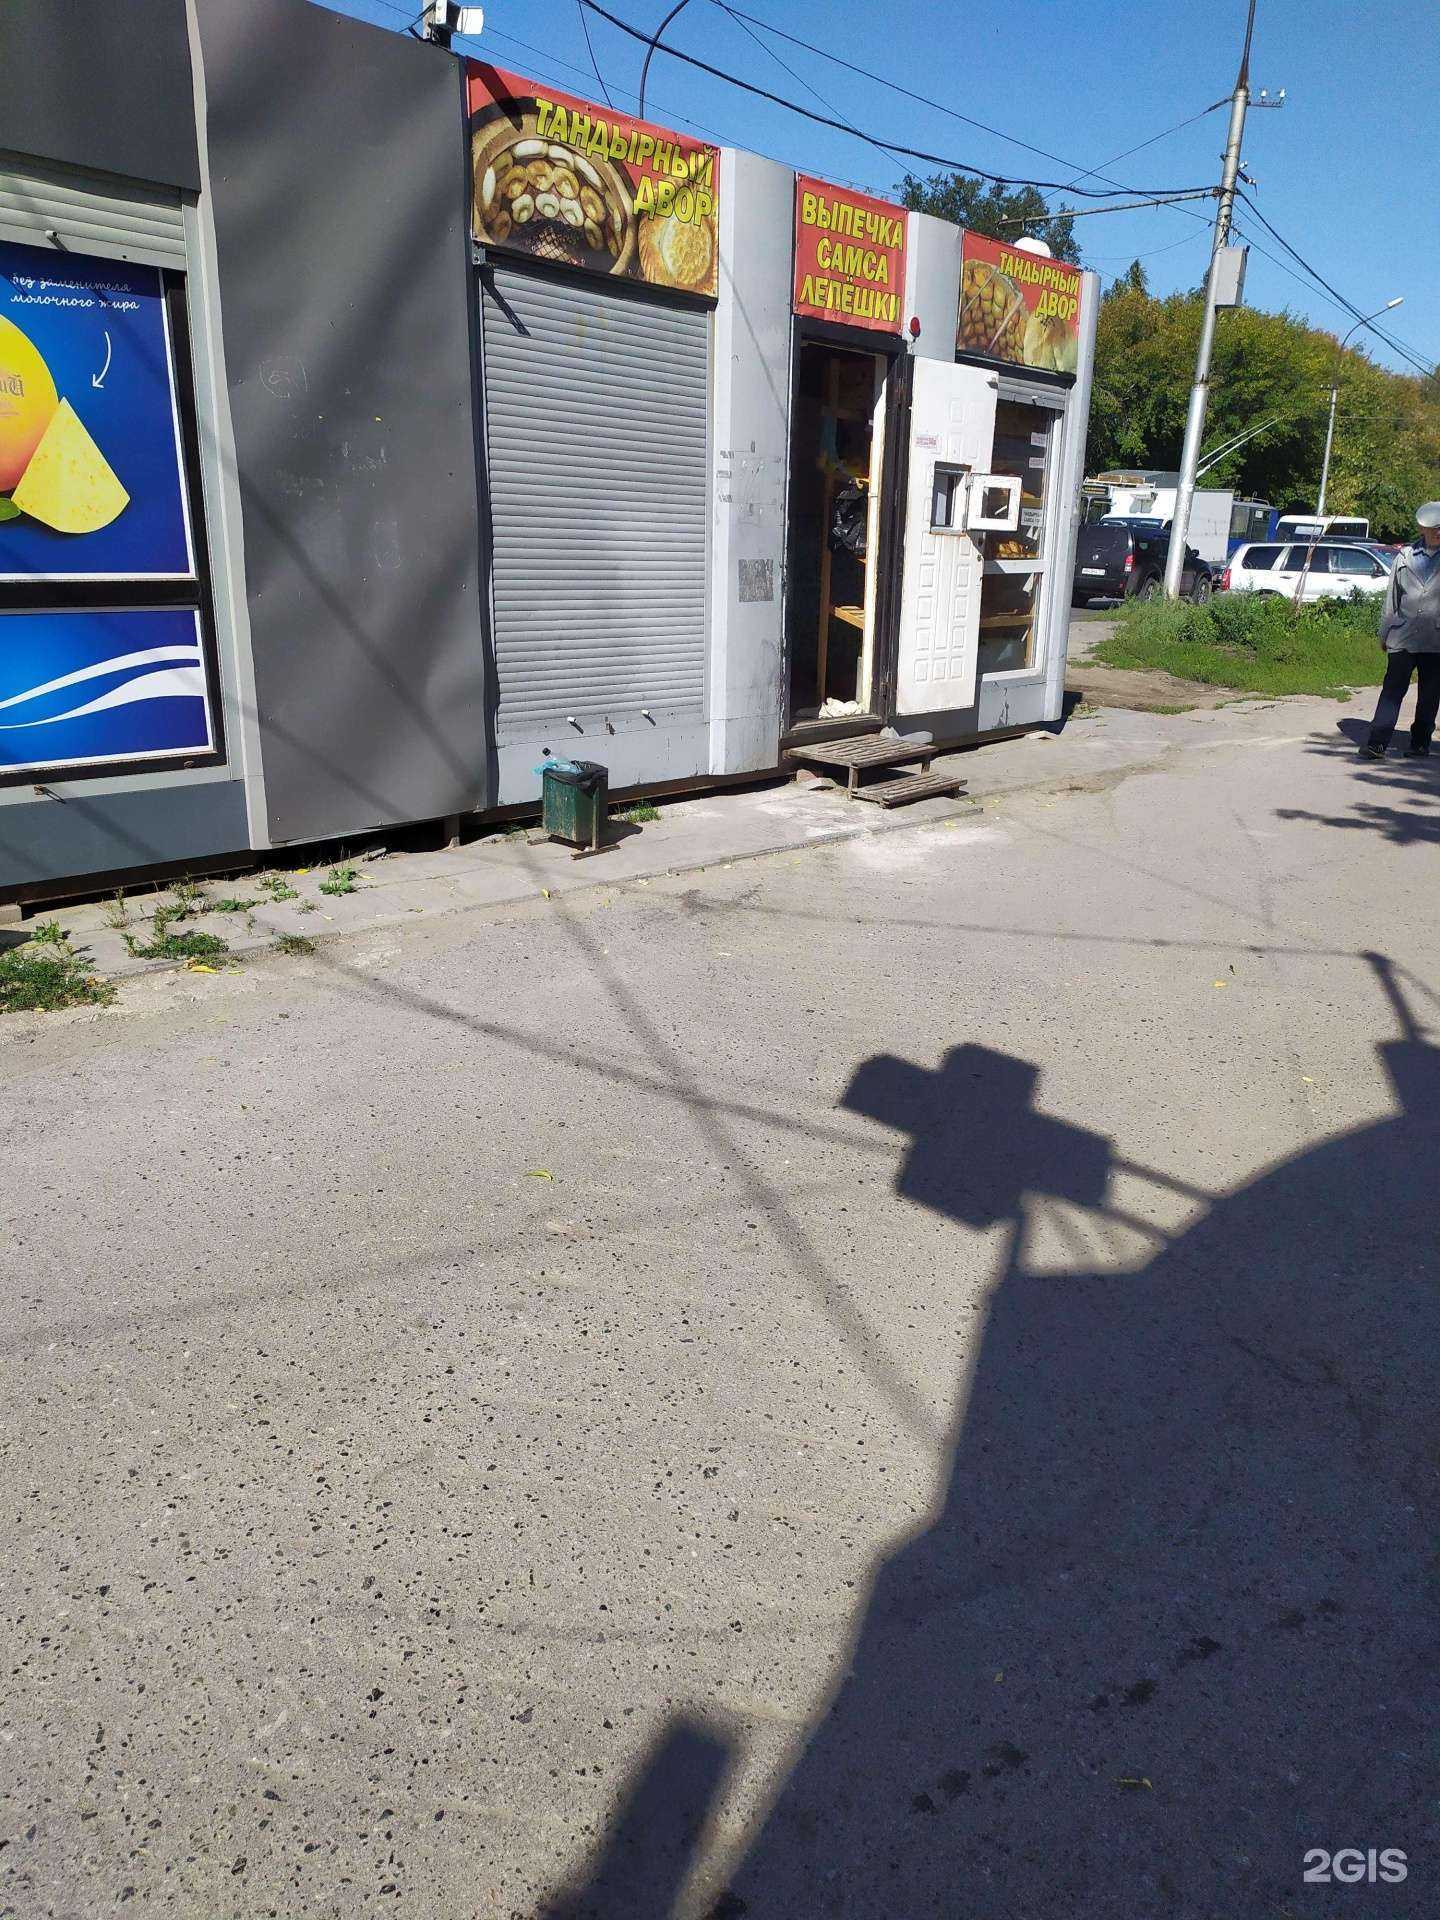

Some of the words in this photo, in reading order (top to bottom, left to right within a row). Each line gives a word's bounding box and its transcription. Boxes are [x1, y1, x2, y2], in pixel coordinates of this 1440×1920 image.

[535, 97, 714, 187] ТАНДЫРНЫЙ
[632, 175, 712, 227] ДВОР
[801, 191, 904, 250] ВЫПЕЧКА
[816, 237, 889, 285] САМСА
[1000, 252, 1080, 297] ТАНДЫРНЫЙ
[10, 294, 95, 308] молочного
[98, 299, 140, 312] жира
[799, 274, 902, 322] ЛЕПЁШКИ
[1035, 288, 1078, 321] ДВОР
